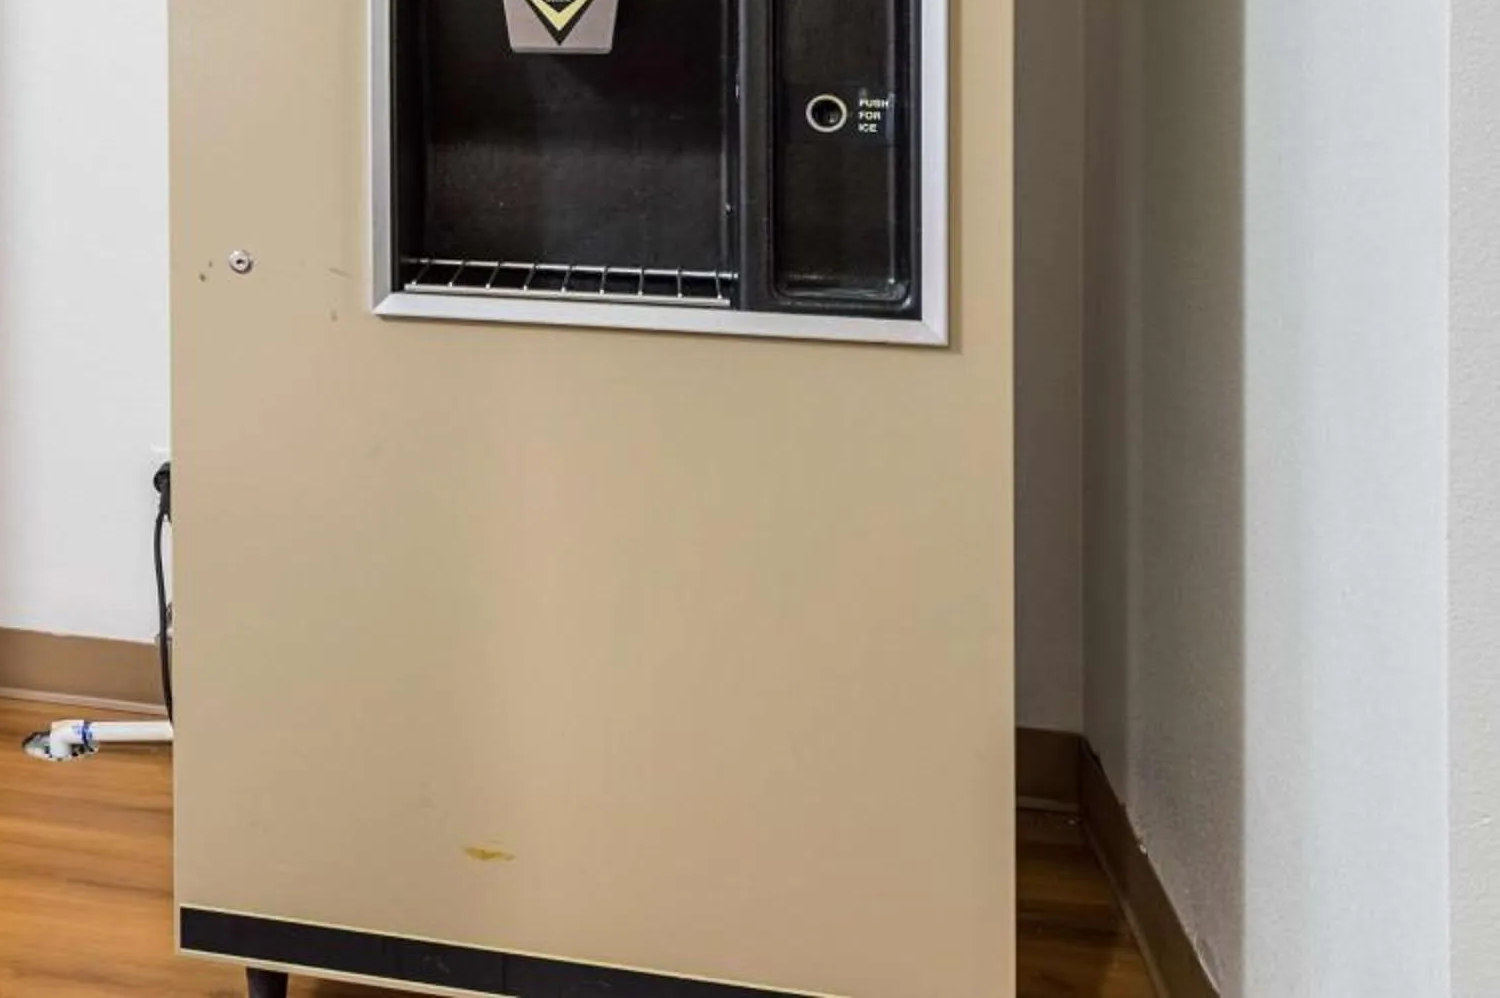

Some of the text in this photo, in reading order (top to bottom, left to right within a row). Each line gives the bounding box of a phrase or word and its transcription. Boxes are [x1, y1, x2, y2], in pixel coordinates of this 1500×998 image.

[859, 98, 890, 108] PUSH
[858, 111, 882, 121] FOR
[858, 123, 878, 133] ICE
